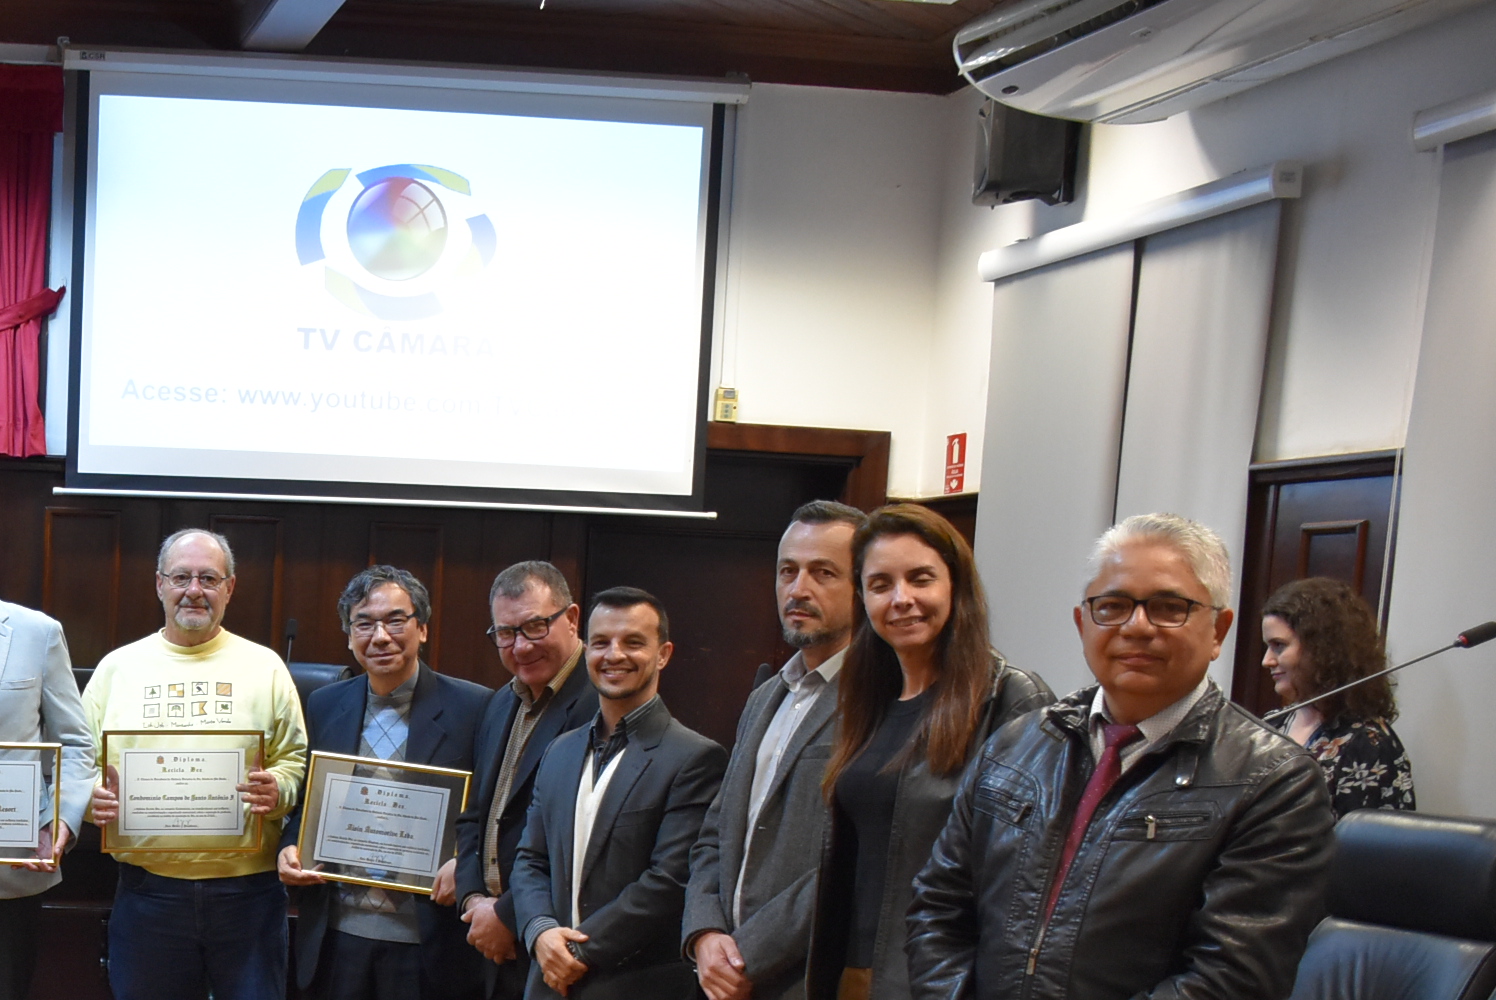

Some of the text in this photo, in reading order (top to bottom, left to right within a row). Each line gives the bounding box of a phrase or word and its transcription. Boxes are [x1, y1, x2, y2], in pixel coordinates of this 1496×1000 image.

[297, 327, 341, 351] TV
[121, 378, 228, 405] Acesse:
[377, 789, 410, 799] Diploma
